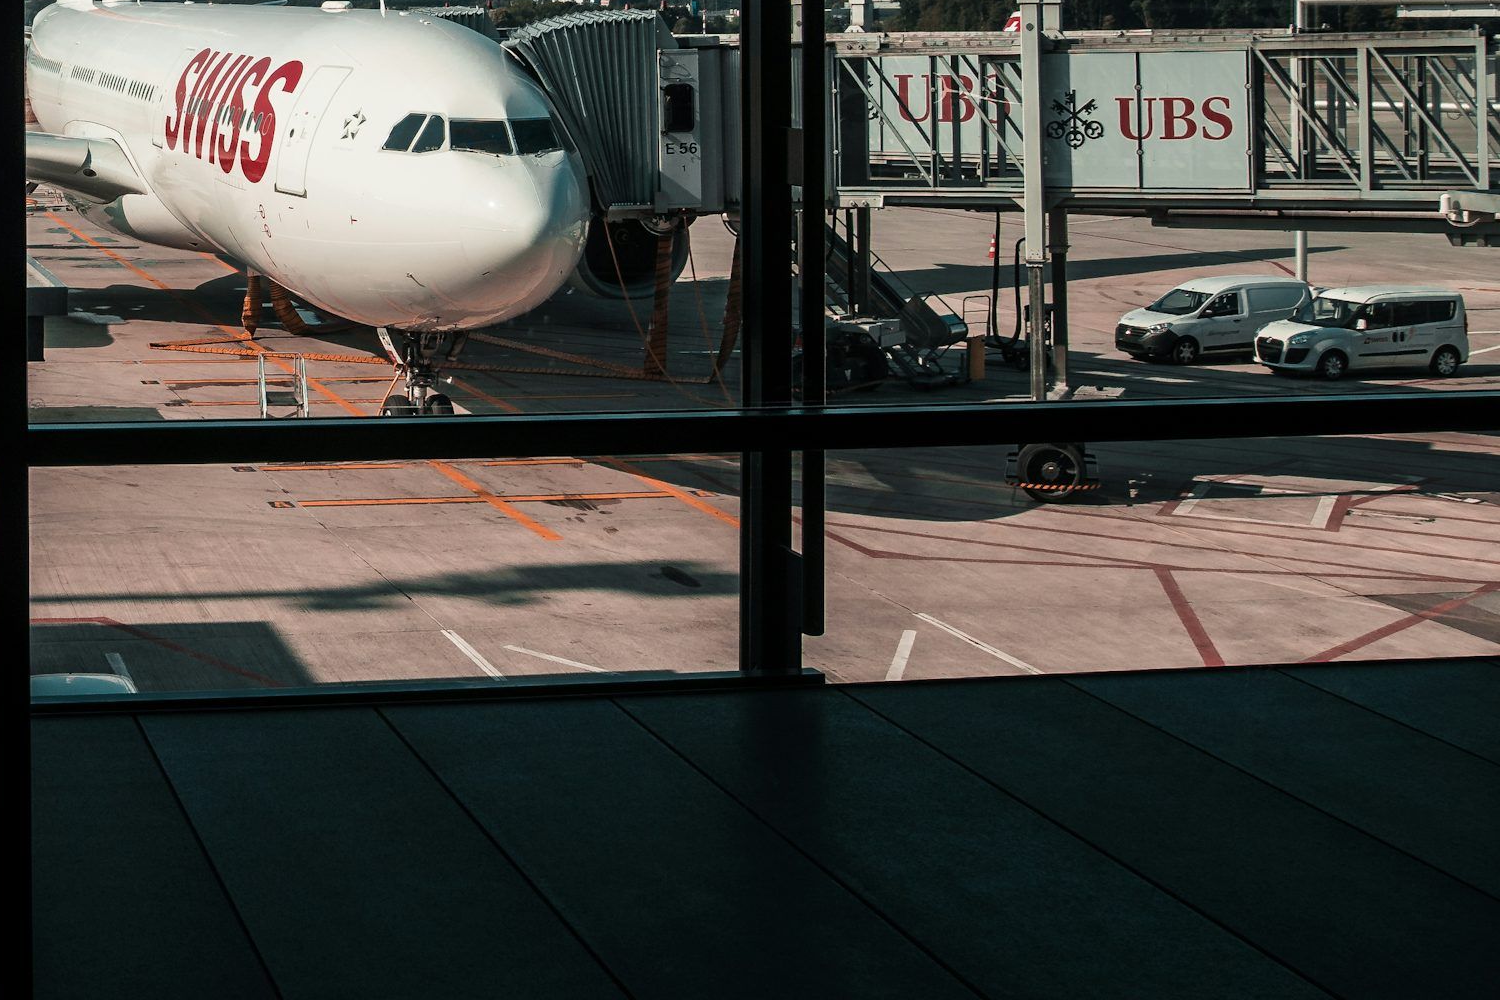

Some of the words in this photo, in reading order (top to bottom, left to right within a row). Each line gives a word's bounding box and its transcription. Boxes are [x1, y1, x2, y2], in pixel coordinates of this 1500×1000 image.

[165, 47, 304, 183] SWISS
[1114, 96, 1233, 140] UBS
[666, 142, 675, 155] E
[679, 142, 698, 155] 56
[681, 164, 686, 172] 1
